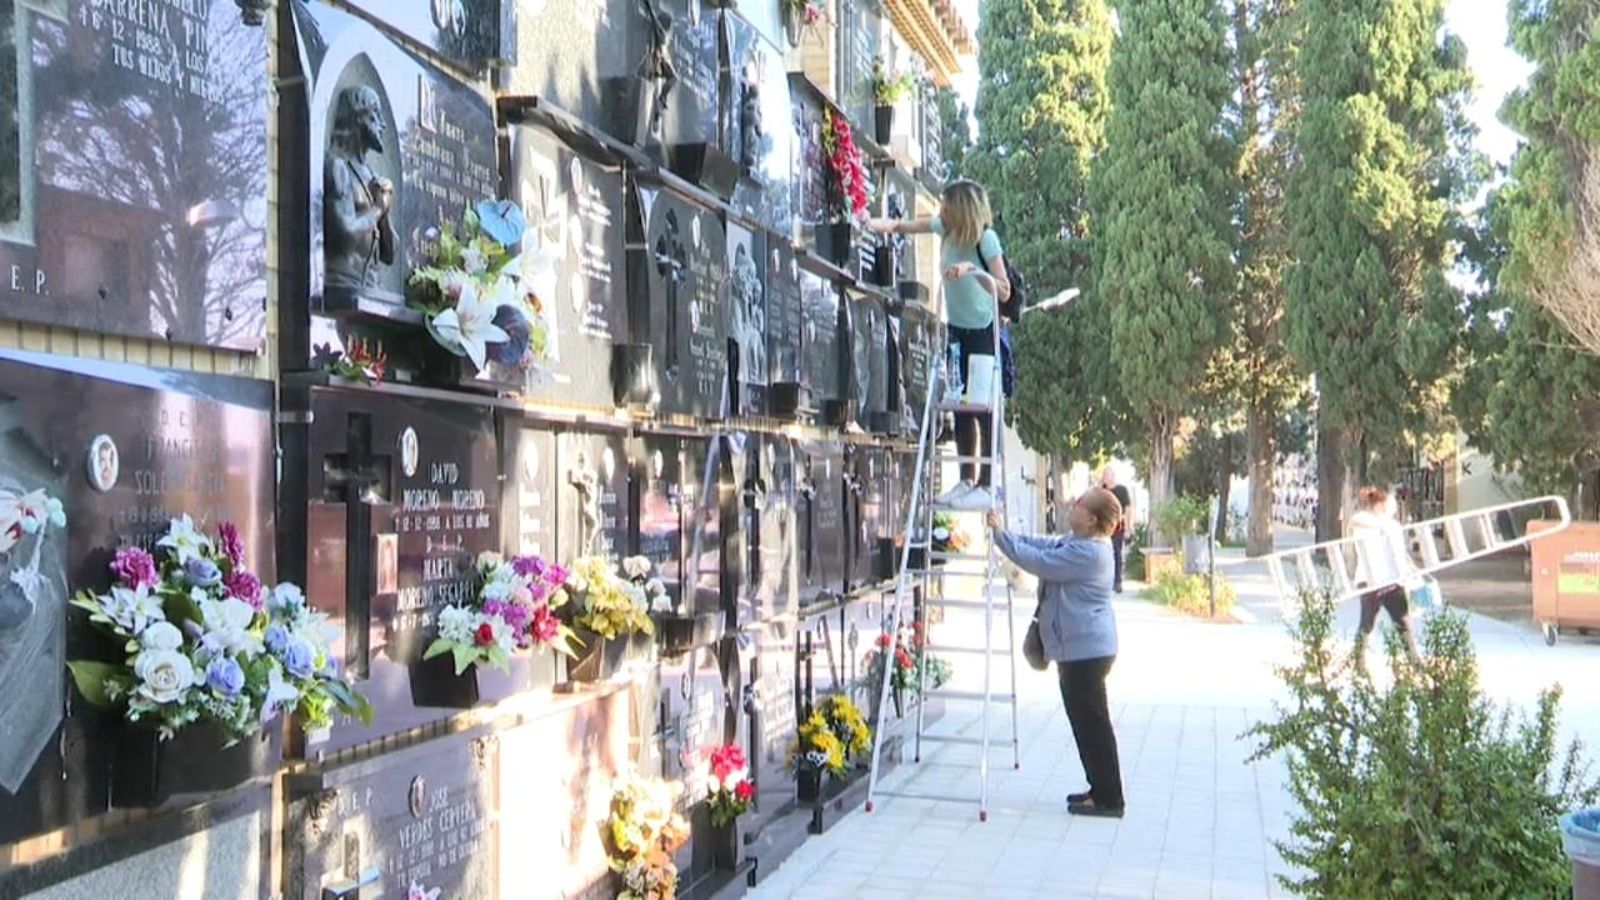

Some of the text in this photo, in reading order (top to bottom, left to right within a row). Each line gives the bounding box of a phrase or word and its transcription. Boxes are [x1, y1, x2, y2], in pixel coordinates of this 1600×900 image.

[112, 43, 134, 70] TUS
[431, 462, 458, 484] DAVID
[403, 489, 485, 512] MORENO MORENO
[397, 585, 433, 612] MORENO
